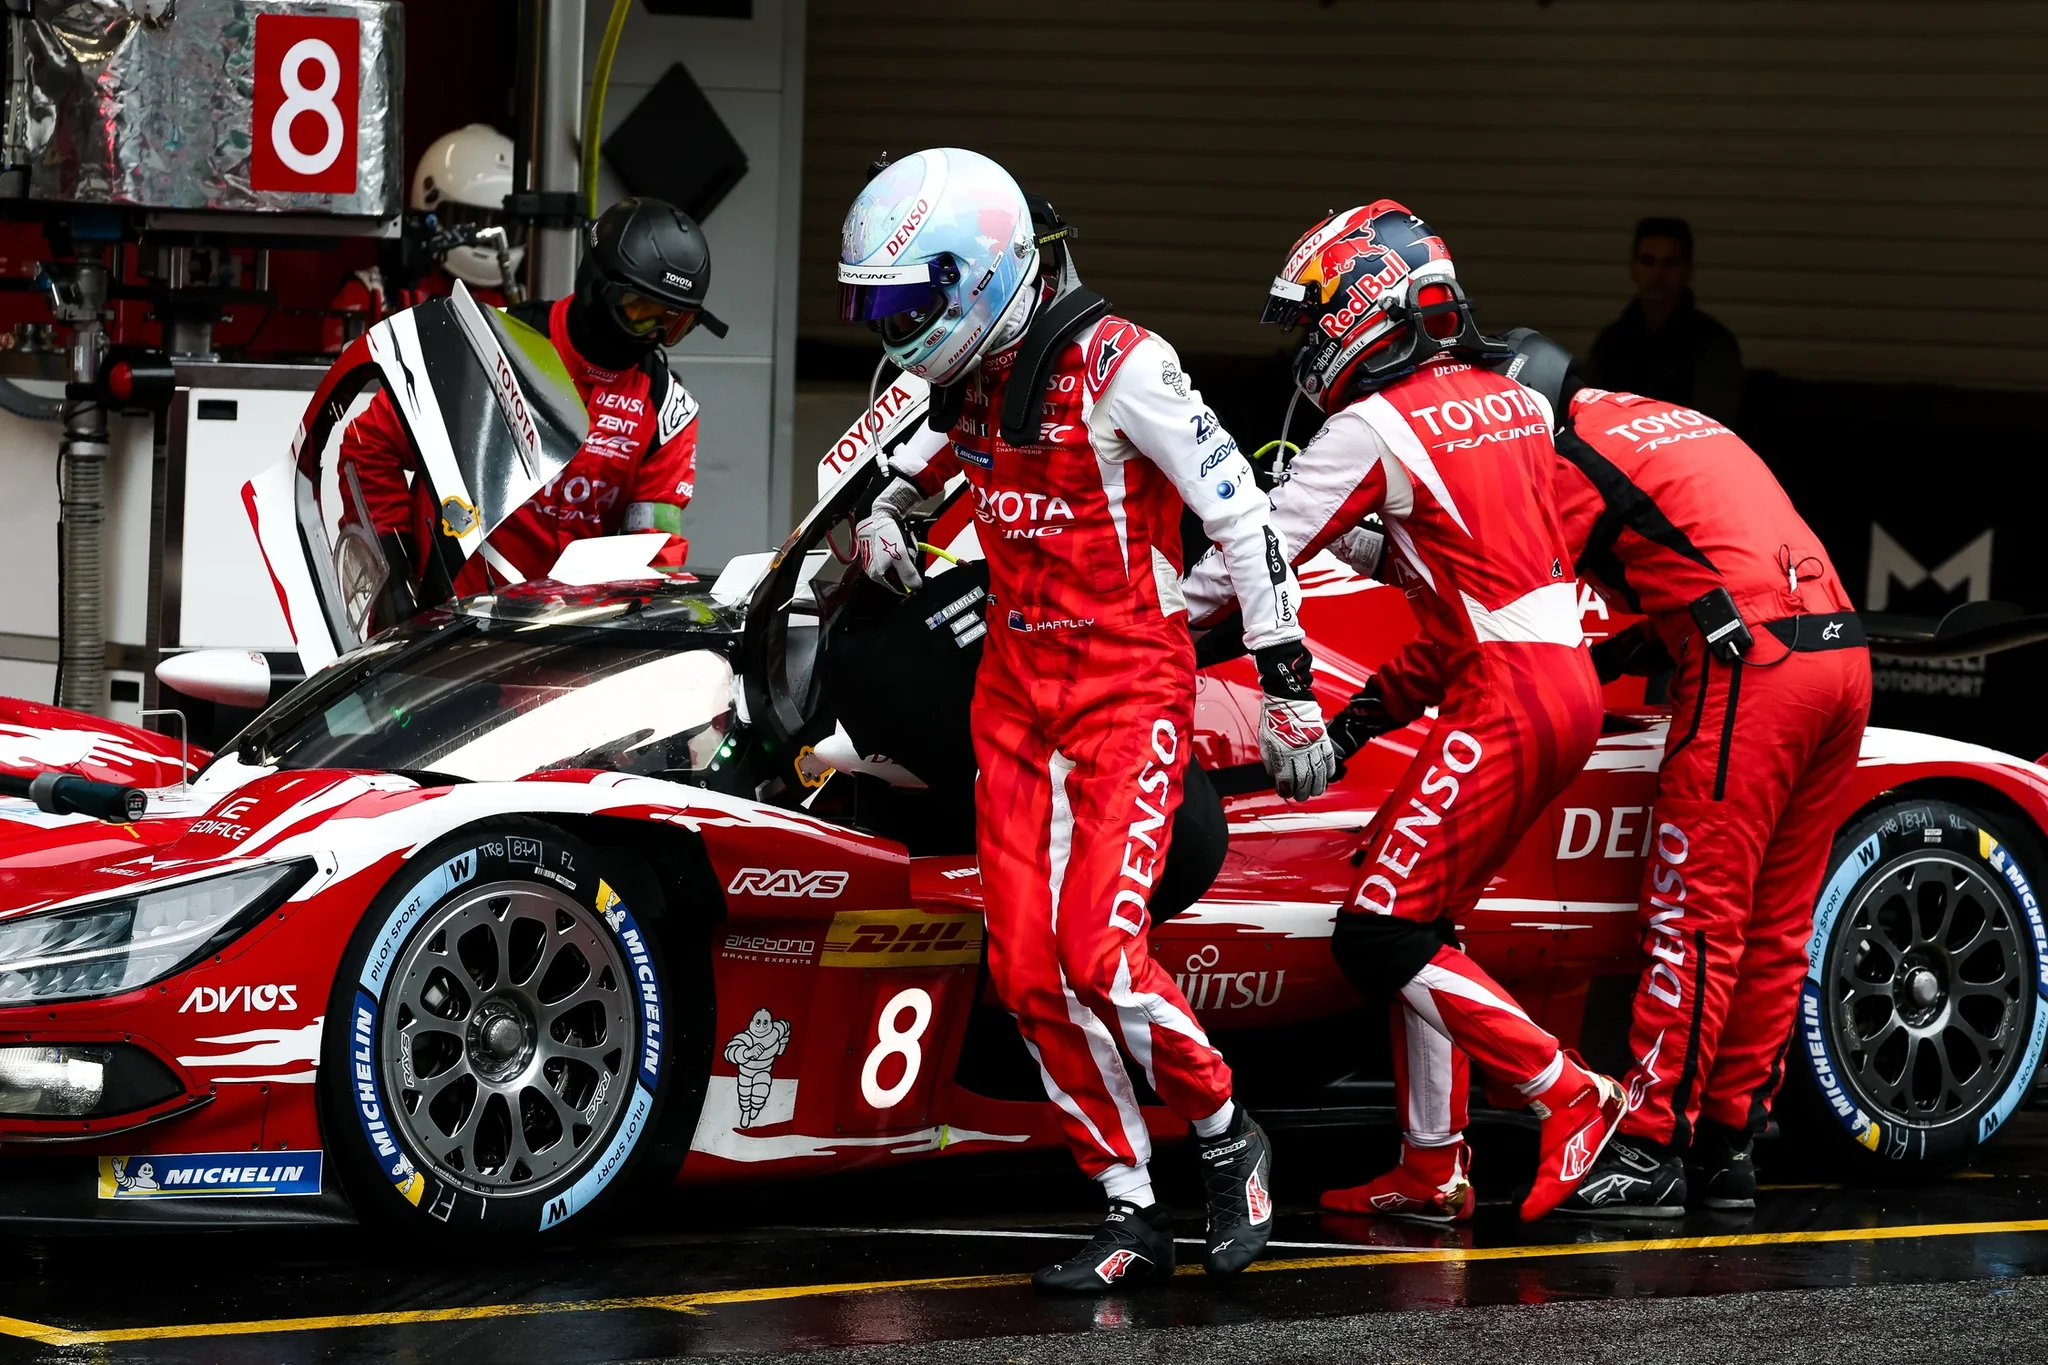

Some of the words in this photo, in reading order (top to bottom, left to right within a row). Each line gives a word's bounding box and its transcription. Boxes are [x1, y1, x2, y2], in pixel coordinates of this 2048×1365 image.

[272, 38, 344, 175] 8
[886, 198, 929, 257] DENSO
[1284, 233, 1322, 281] DENSO
[665, 271, 693, 288] TOYOTA
[1320, 286, 1368, 338] Red
[1357, 249, 1411, 301] Bull
[925, 328, 944, 346] BELL
[1325, 357, 1348, 384] RICHARD
[1345, 340, 1366, 359] MILLE
[494, 352, 537, 450] TOYOTA
[1411, 389, 1542, 436] TOYOTA
[596, 414, 639, 435] ZENT
[822, 385, 912, 475] TOYOTA
[1197, 434, 1208, 445] LE
[1431, 423, 1547, 453] RACING
[959, 449, 989, 464] MICHELIN
[1267, 533, 1283, 574] Group
[1872, 670, 1984, 696] OTORSPORT
[188, 820, 251, 841] EDIFICE
[1108, 718, 1178, 937] DENSO
[1354, 729, 1484, 916] DENSO
[448, 855, 470, 884] W
[1857, 840, 1875, 867] W
[728, 867, 850, 898] RAYS
[1648, 822, 1689, 1009] DENSO
[1810, 926, 1824, 970] PILOT
[1820, 885, 1843, 929] SPORT
[2005, 864, 2048, 985] MICHELIN
[370, 935, 392, 982] PILOT
[390, 895, 422, 938] SPORT
[722, 953, 758, 961] BRAKE
[725, 934, 815, 953] akebono
[846, 922, 968, 953] DHL
[178, 984, 298, 1013] ADVICS
[623, 928, 661, 1076] MICHELIN
[861, 988, 932, 1109] 8
[2035, 1010, 2047, 1048] PILOT
[1803, 994, 1854, 1118] MICHELIN
[2017, 1049, 2037, 1092] SPORT
[356, 1006, 397, 1158] MICHELIN
[624, 1100, 646, 1142] PILOT
[1982, 1112, 1999, 1138] W
[164, 1166, 304, 1184] MICHELIN
[595, 1143, 627, 1185] SPORT
[547, 1198, 568, 1224] W
